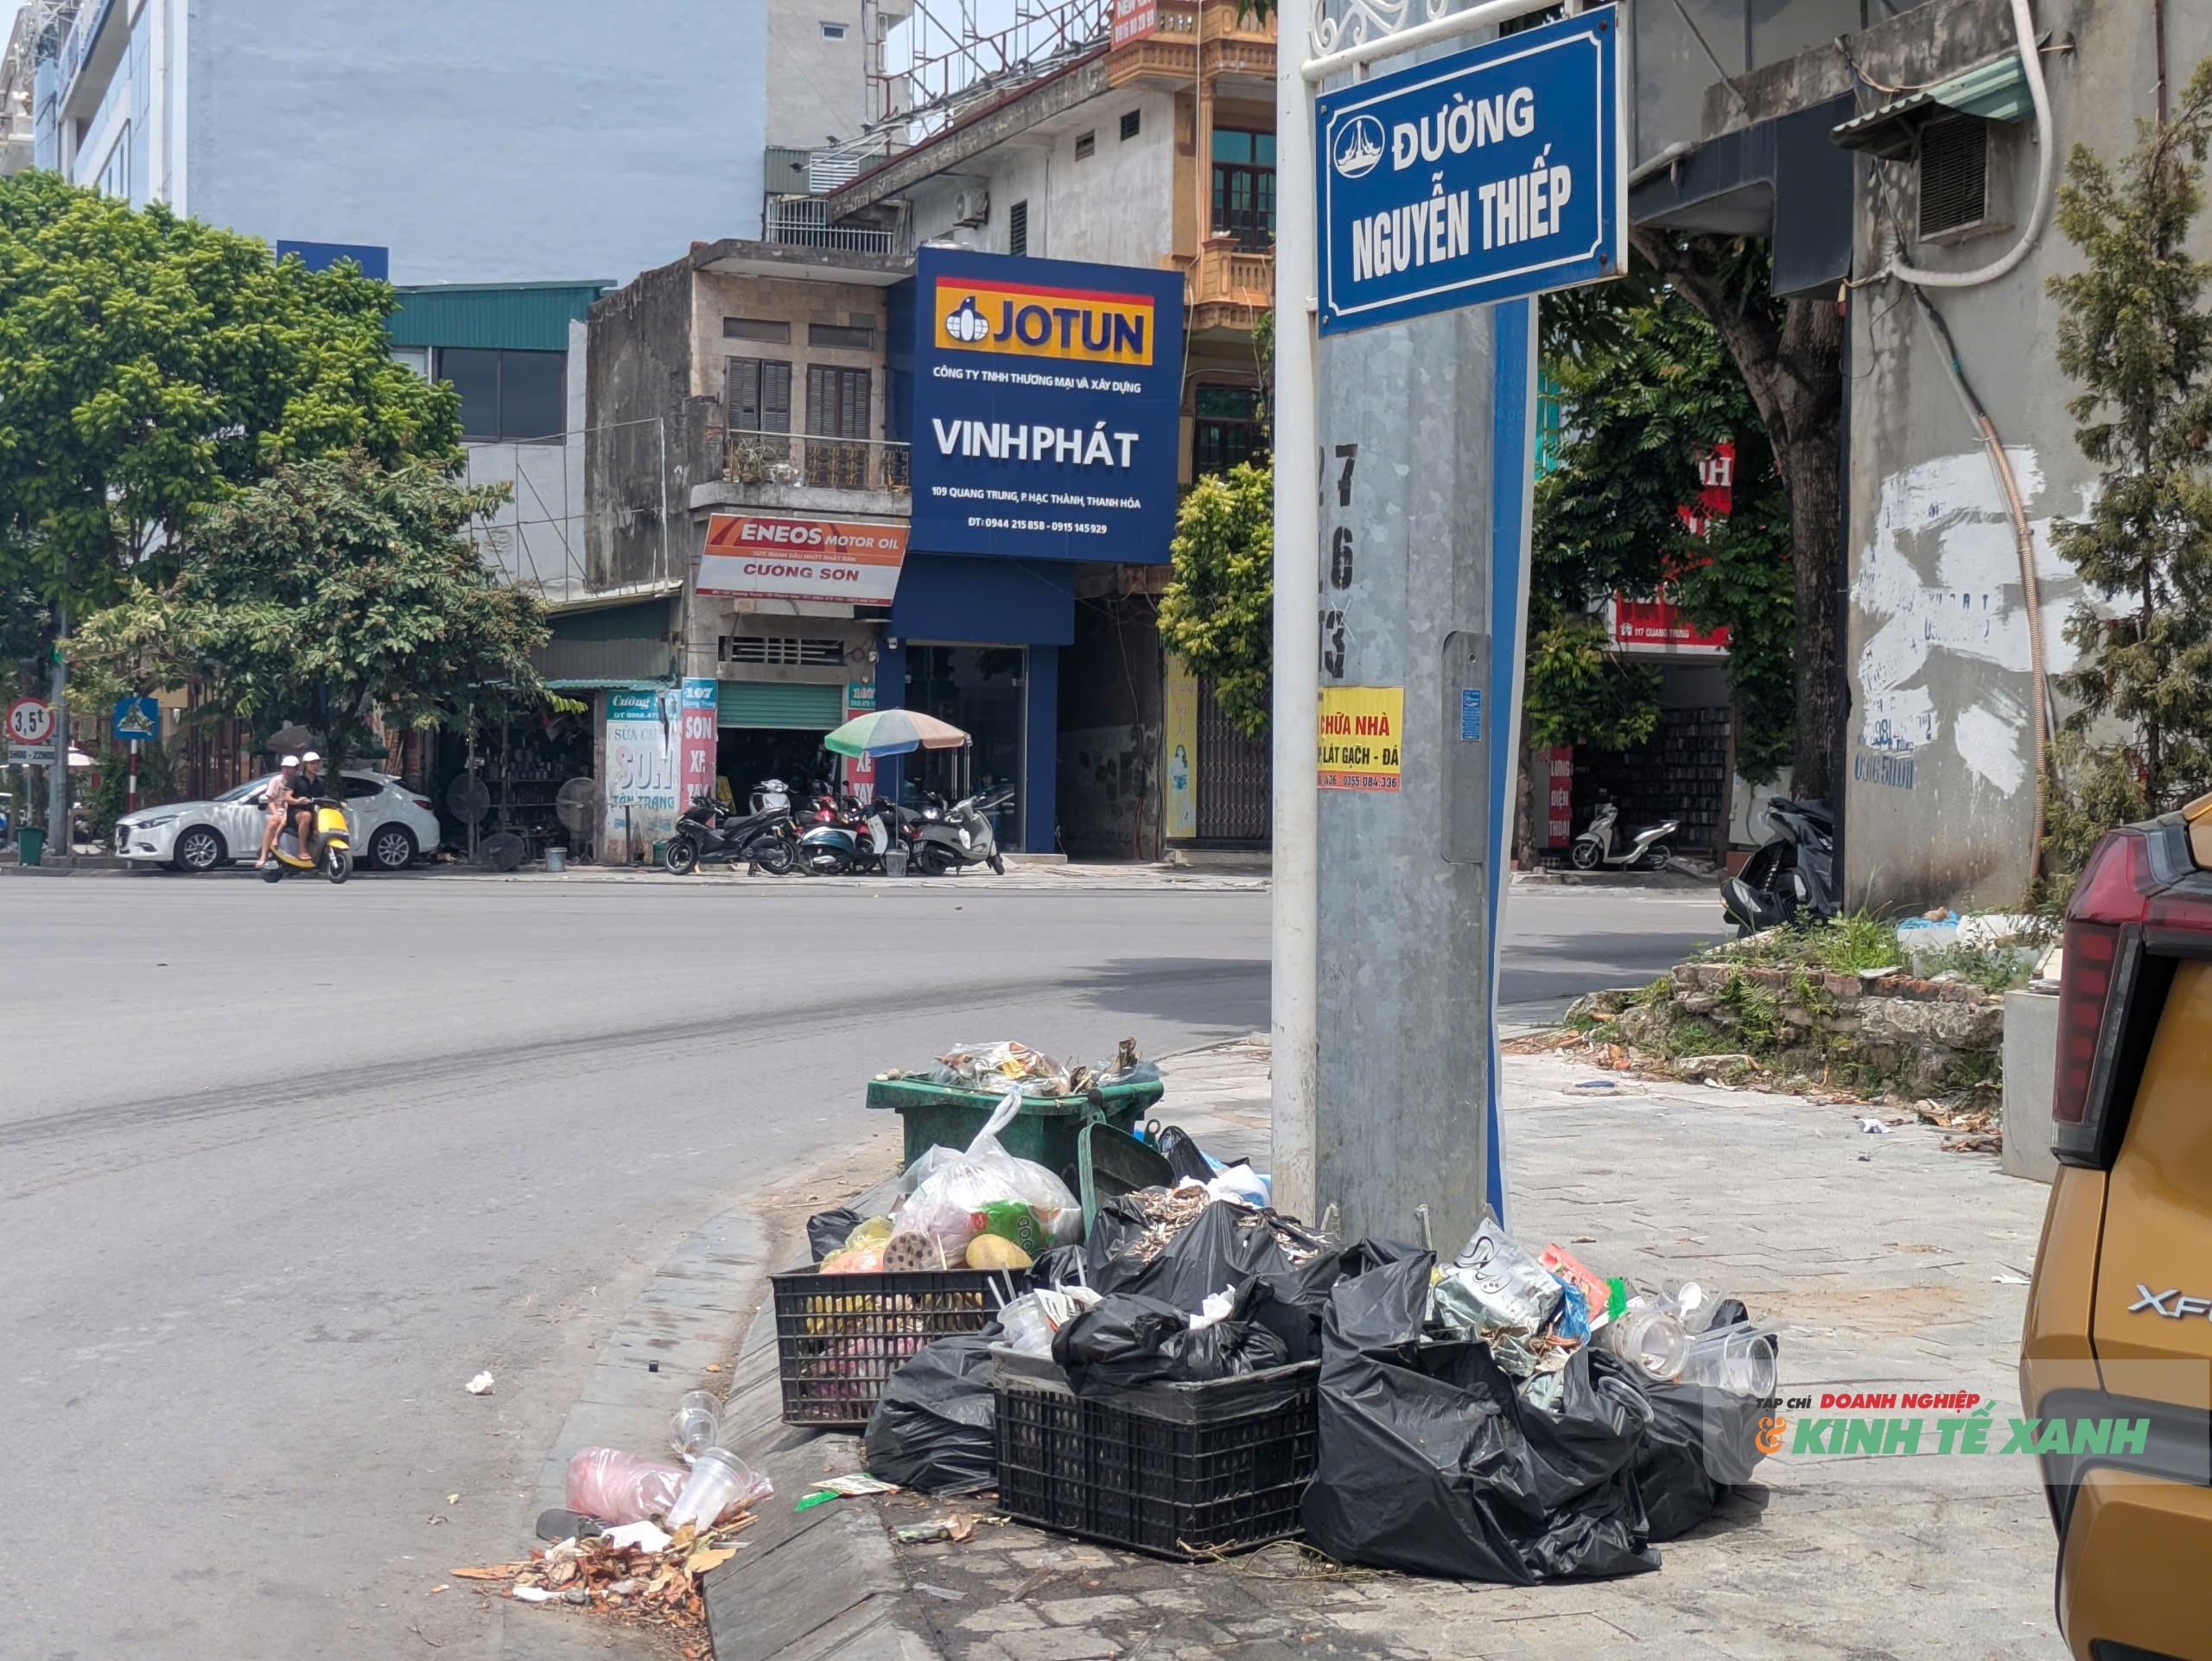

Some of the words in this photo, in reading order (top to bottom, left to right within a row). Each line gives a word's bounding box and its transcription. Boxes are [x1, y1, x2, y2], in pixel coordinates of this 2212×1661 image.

[1392, 87, 1534, 171] ĐƯỜNG
[1353, 171, 1469, 282] NGUYỄN
[1479, 143, 1572, 250] THIẾP
[994, 301, 1145, 354] JOTUN
[933, 365, 963, 379] CÔNG
[965, 370, 979, 380] TY
[982, 371, 1008, 383] TNHH
[1010, 373, 1052, 386] THƯƠNG
[1054, 378, 1074, 390] MẠI
[1076, 377, 1089, 389] VÀ
[1090, 378, 1111, 391] XÂY
[1112, 381, 1141, 394] DỰNG
[932, 418, 1028, 460] VINH
[1033, 421, 1139, 467] PHÁT
[931, 487, 947, 496] 109
[949, 487, 984, 499] QUANG
[986, 490, 1019, 503] TRUNG,
[1028, 493, 1049, 505] HẠC
[1050, 493, 1085, 507] THÀNH,
[1087, 496, 1118, 507] THANH
[1120, 497, 1141, 509] HÓA
[741, 524, 823, 544] ENEOS
[825, 536, 874, 548] MOTOR
[878, 538, 899, 550] OIL
[968, 517, 984, 526] ĐT:
[985, 519, 1009, 528] 0944
[1011, 519, 1027, 529] 215
[1027, 520, 1045, 530] 858
[1052, 521, 1073, 532] 0915
[1090, 524, 1107, 534] 929
[819, 568, 860, 581] SƠN
[1645, 628, 1668, 638] QUANG
[1355, 712, 1389, 736] NHÀ
[1323, 742, 1339, 763] LÁT
[1342, 745, 1370, 767] GẠCH
[1382, 744, 1399, 766] ĐÁ
[638, 795, 675, 810] TRANG
[2127, 1283, 2212, 1323] XF
